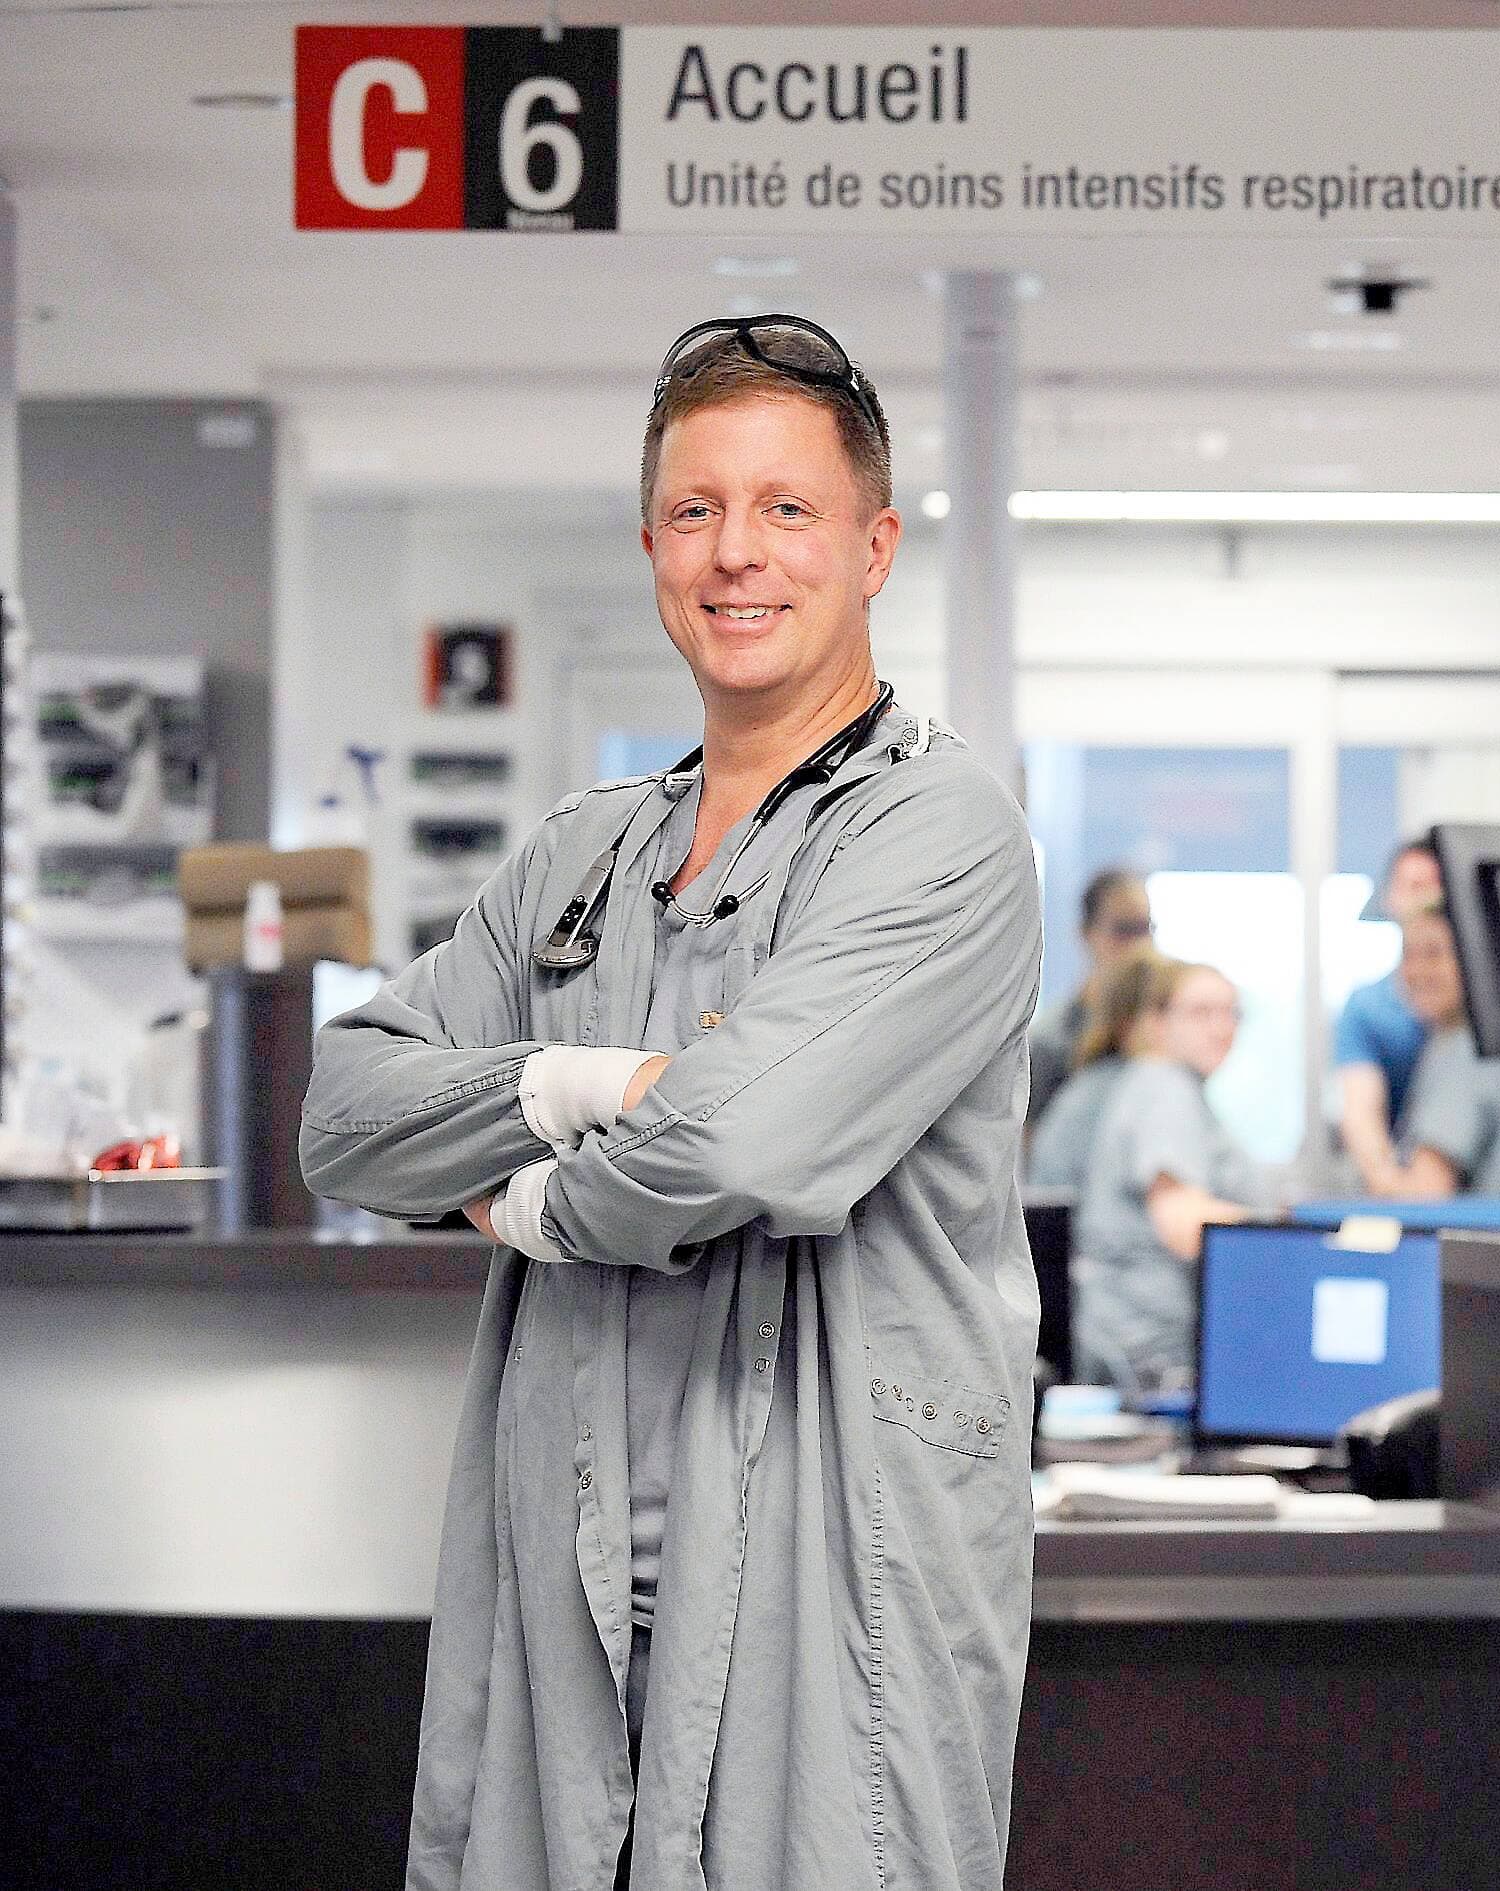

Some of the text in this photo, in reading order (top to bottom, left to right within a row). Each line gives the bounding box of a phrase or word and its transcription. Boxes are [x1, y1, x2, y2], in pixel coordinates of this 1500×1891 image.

[329, 57, 429, 210] C
[664, 43, 969, 124] Accueil
[499, 77, 583, 212] 6
[666, 160, 787, 208] Unité
[805, 163, 861, 208] de
[879, 163, 1003, 208] soins
[1022, 163, 1224, 208] intensifs
